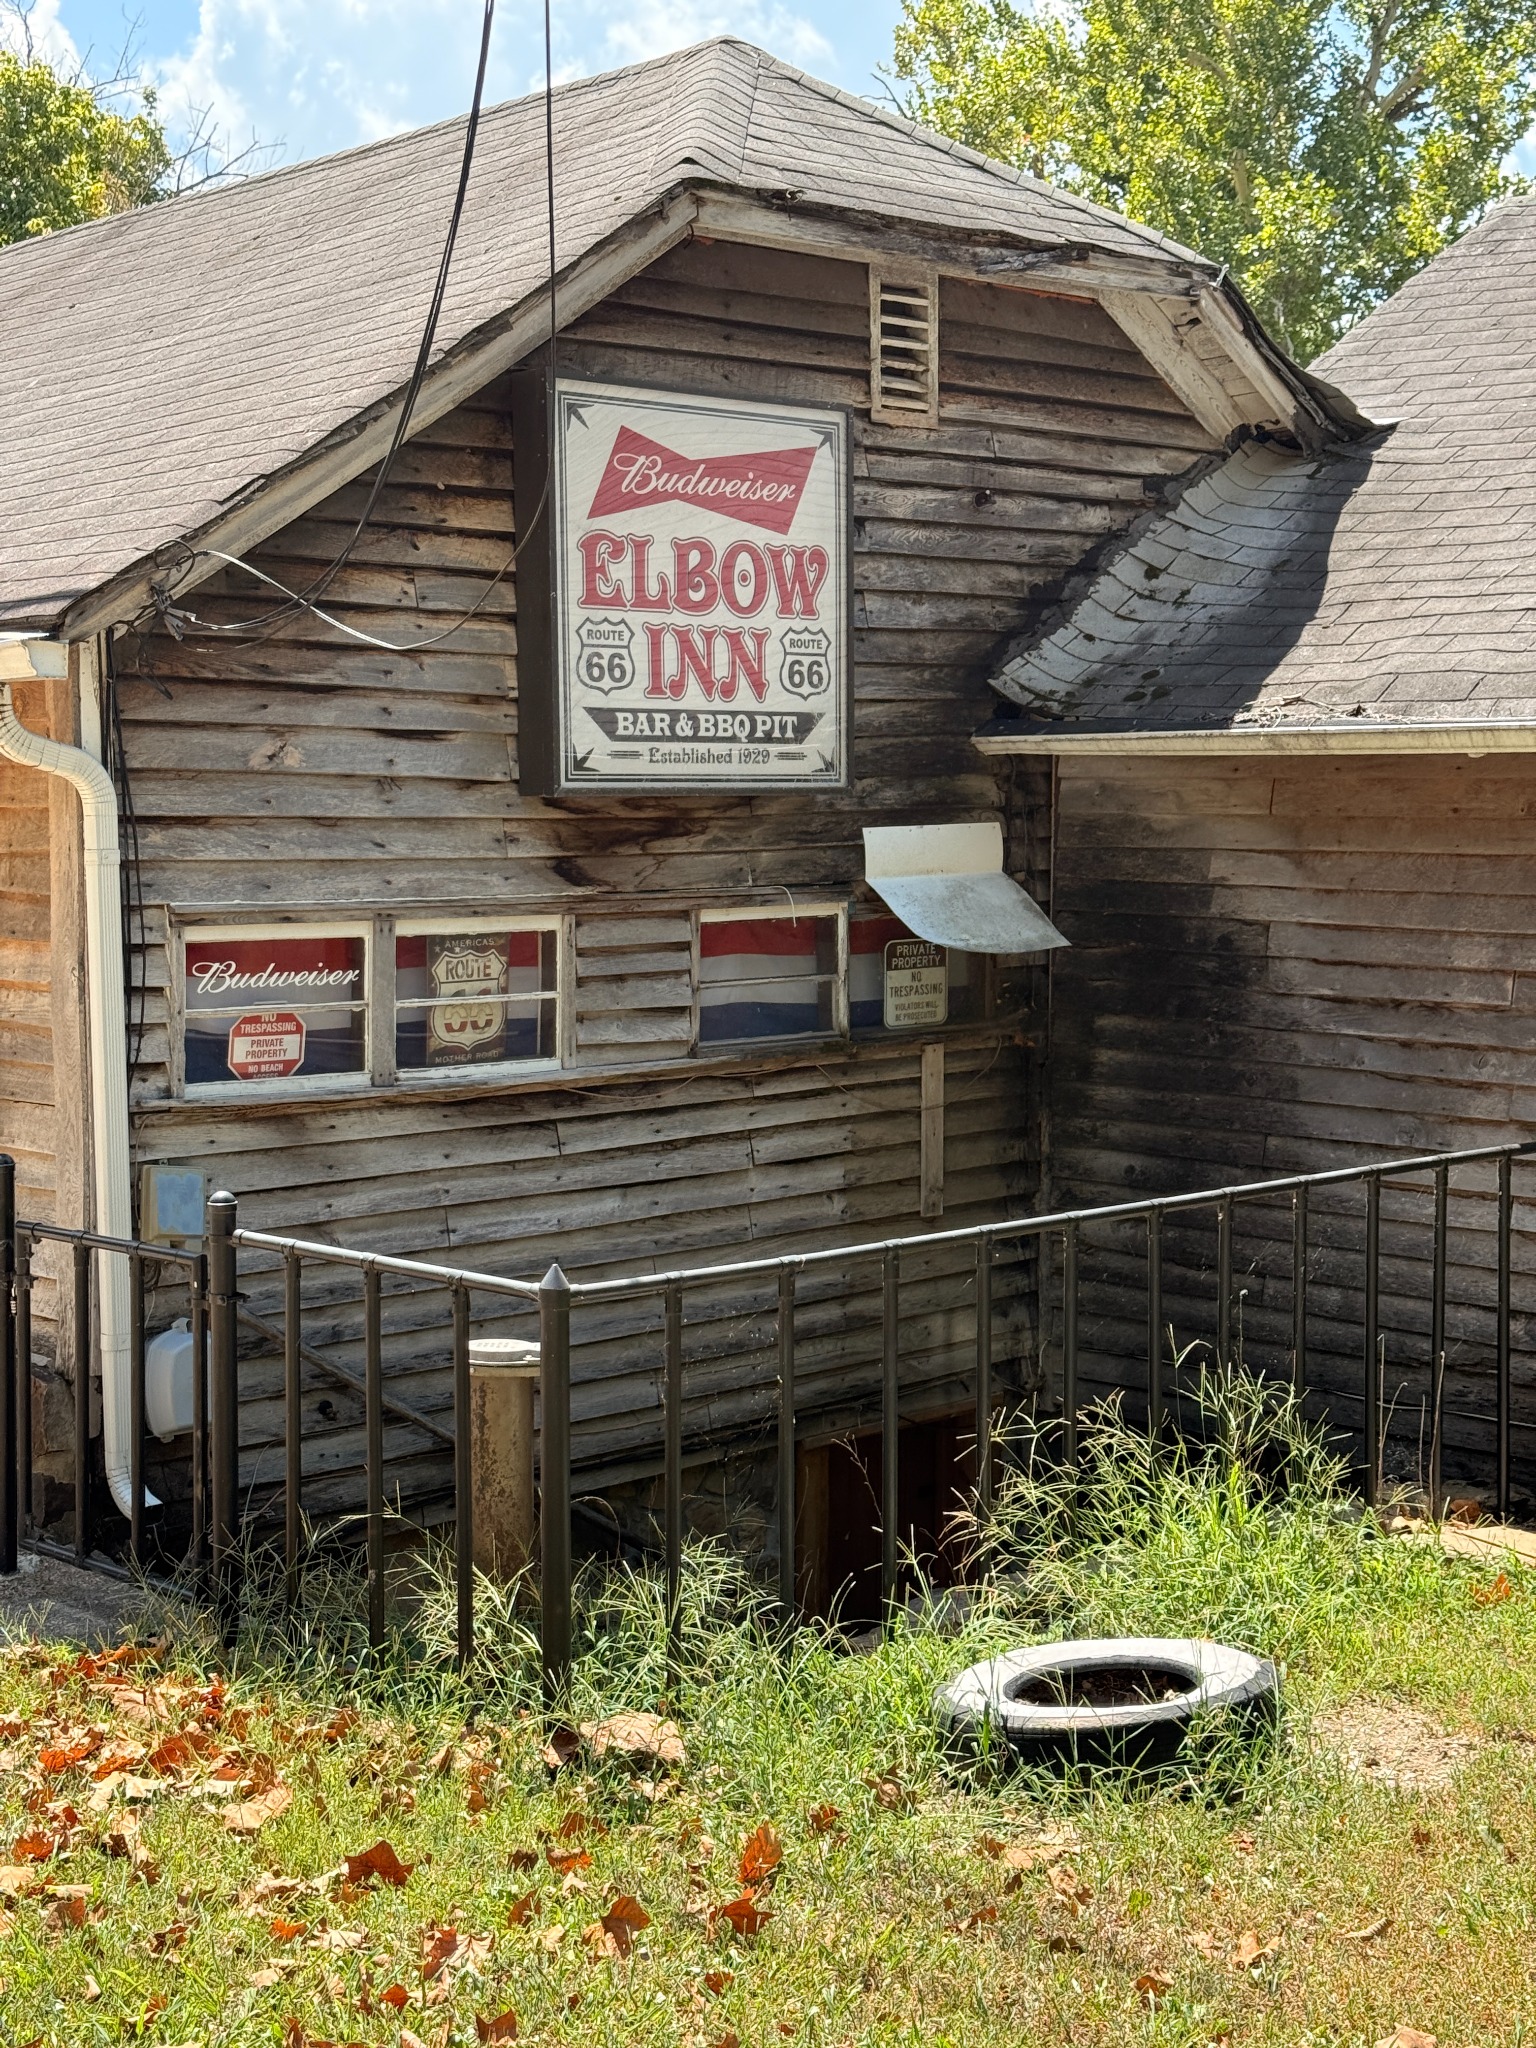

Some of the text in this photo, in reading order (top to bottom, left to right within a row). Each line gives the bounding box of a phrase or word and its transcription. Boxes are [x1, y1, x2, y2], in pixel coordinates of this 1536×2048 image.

[613, 452, 796, 502] Budweiser
[577, 529, 829, 620] ELBOW
[587, 628, 625, 642] ROUTE
[789, 638, 823, 650] ROUTE
[586, 651, 627, 683] 66
[642, 622, 771, 703] INN
[787, 659, 824, 689] 66
[615, 711, 798, 743] BAR & BBQ PIT
[648, 746, 770, 765] Established 1929
[896, 943, 937, 956] PRIVATE
[891, 954, 941, 969] PROPERTY
[192, 960, 360, 994] Budweiser
[445, 958, 492, 981] ROUTE
[911, 971, 922, 982] NO
[889, 983, 944, 998] TRESPASSING
[895, 1001, 925, 1011] VIOLATORS
[240, 1021, 297, 1034] TRESPASSING
[250, 1038, 285, 1048] PRIVATE
[245, 1048, 288, 1060] PROPERTY
[435, 1053, 472, 1064] MOTHER
[248, 1063, 284, 1073] NO BEACH
